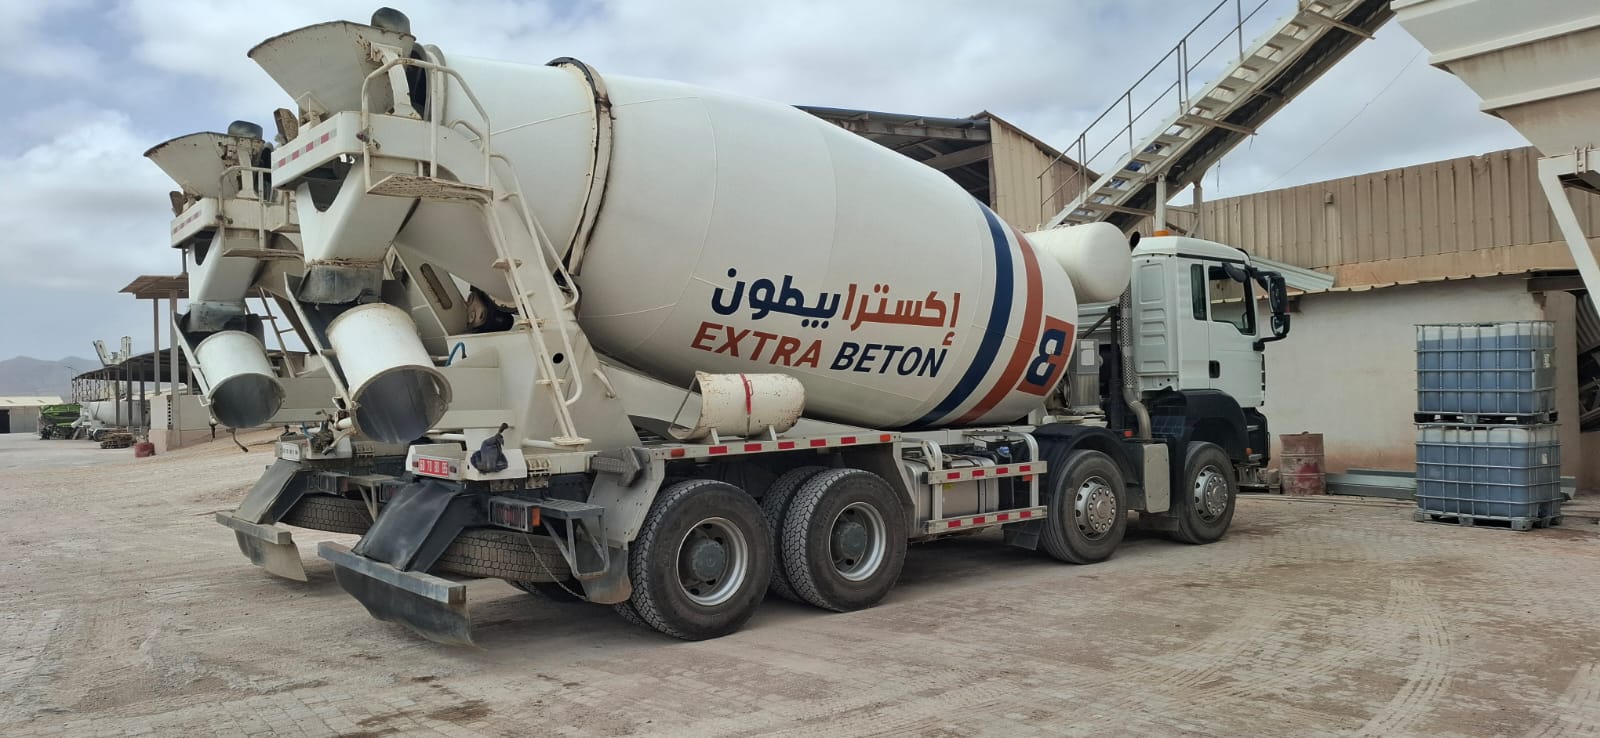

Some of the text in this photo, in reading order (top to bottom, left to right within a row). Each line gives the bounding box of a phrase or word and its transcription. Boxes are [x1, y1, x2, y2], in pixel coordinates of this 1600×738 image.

[711, 268, 960, 346] إكسترا بيطون
[691, 322, 947, 378] EXTRA BETON
